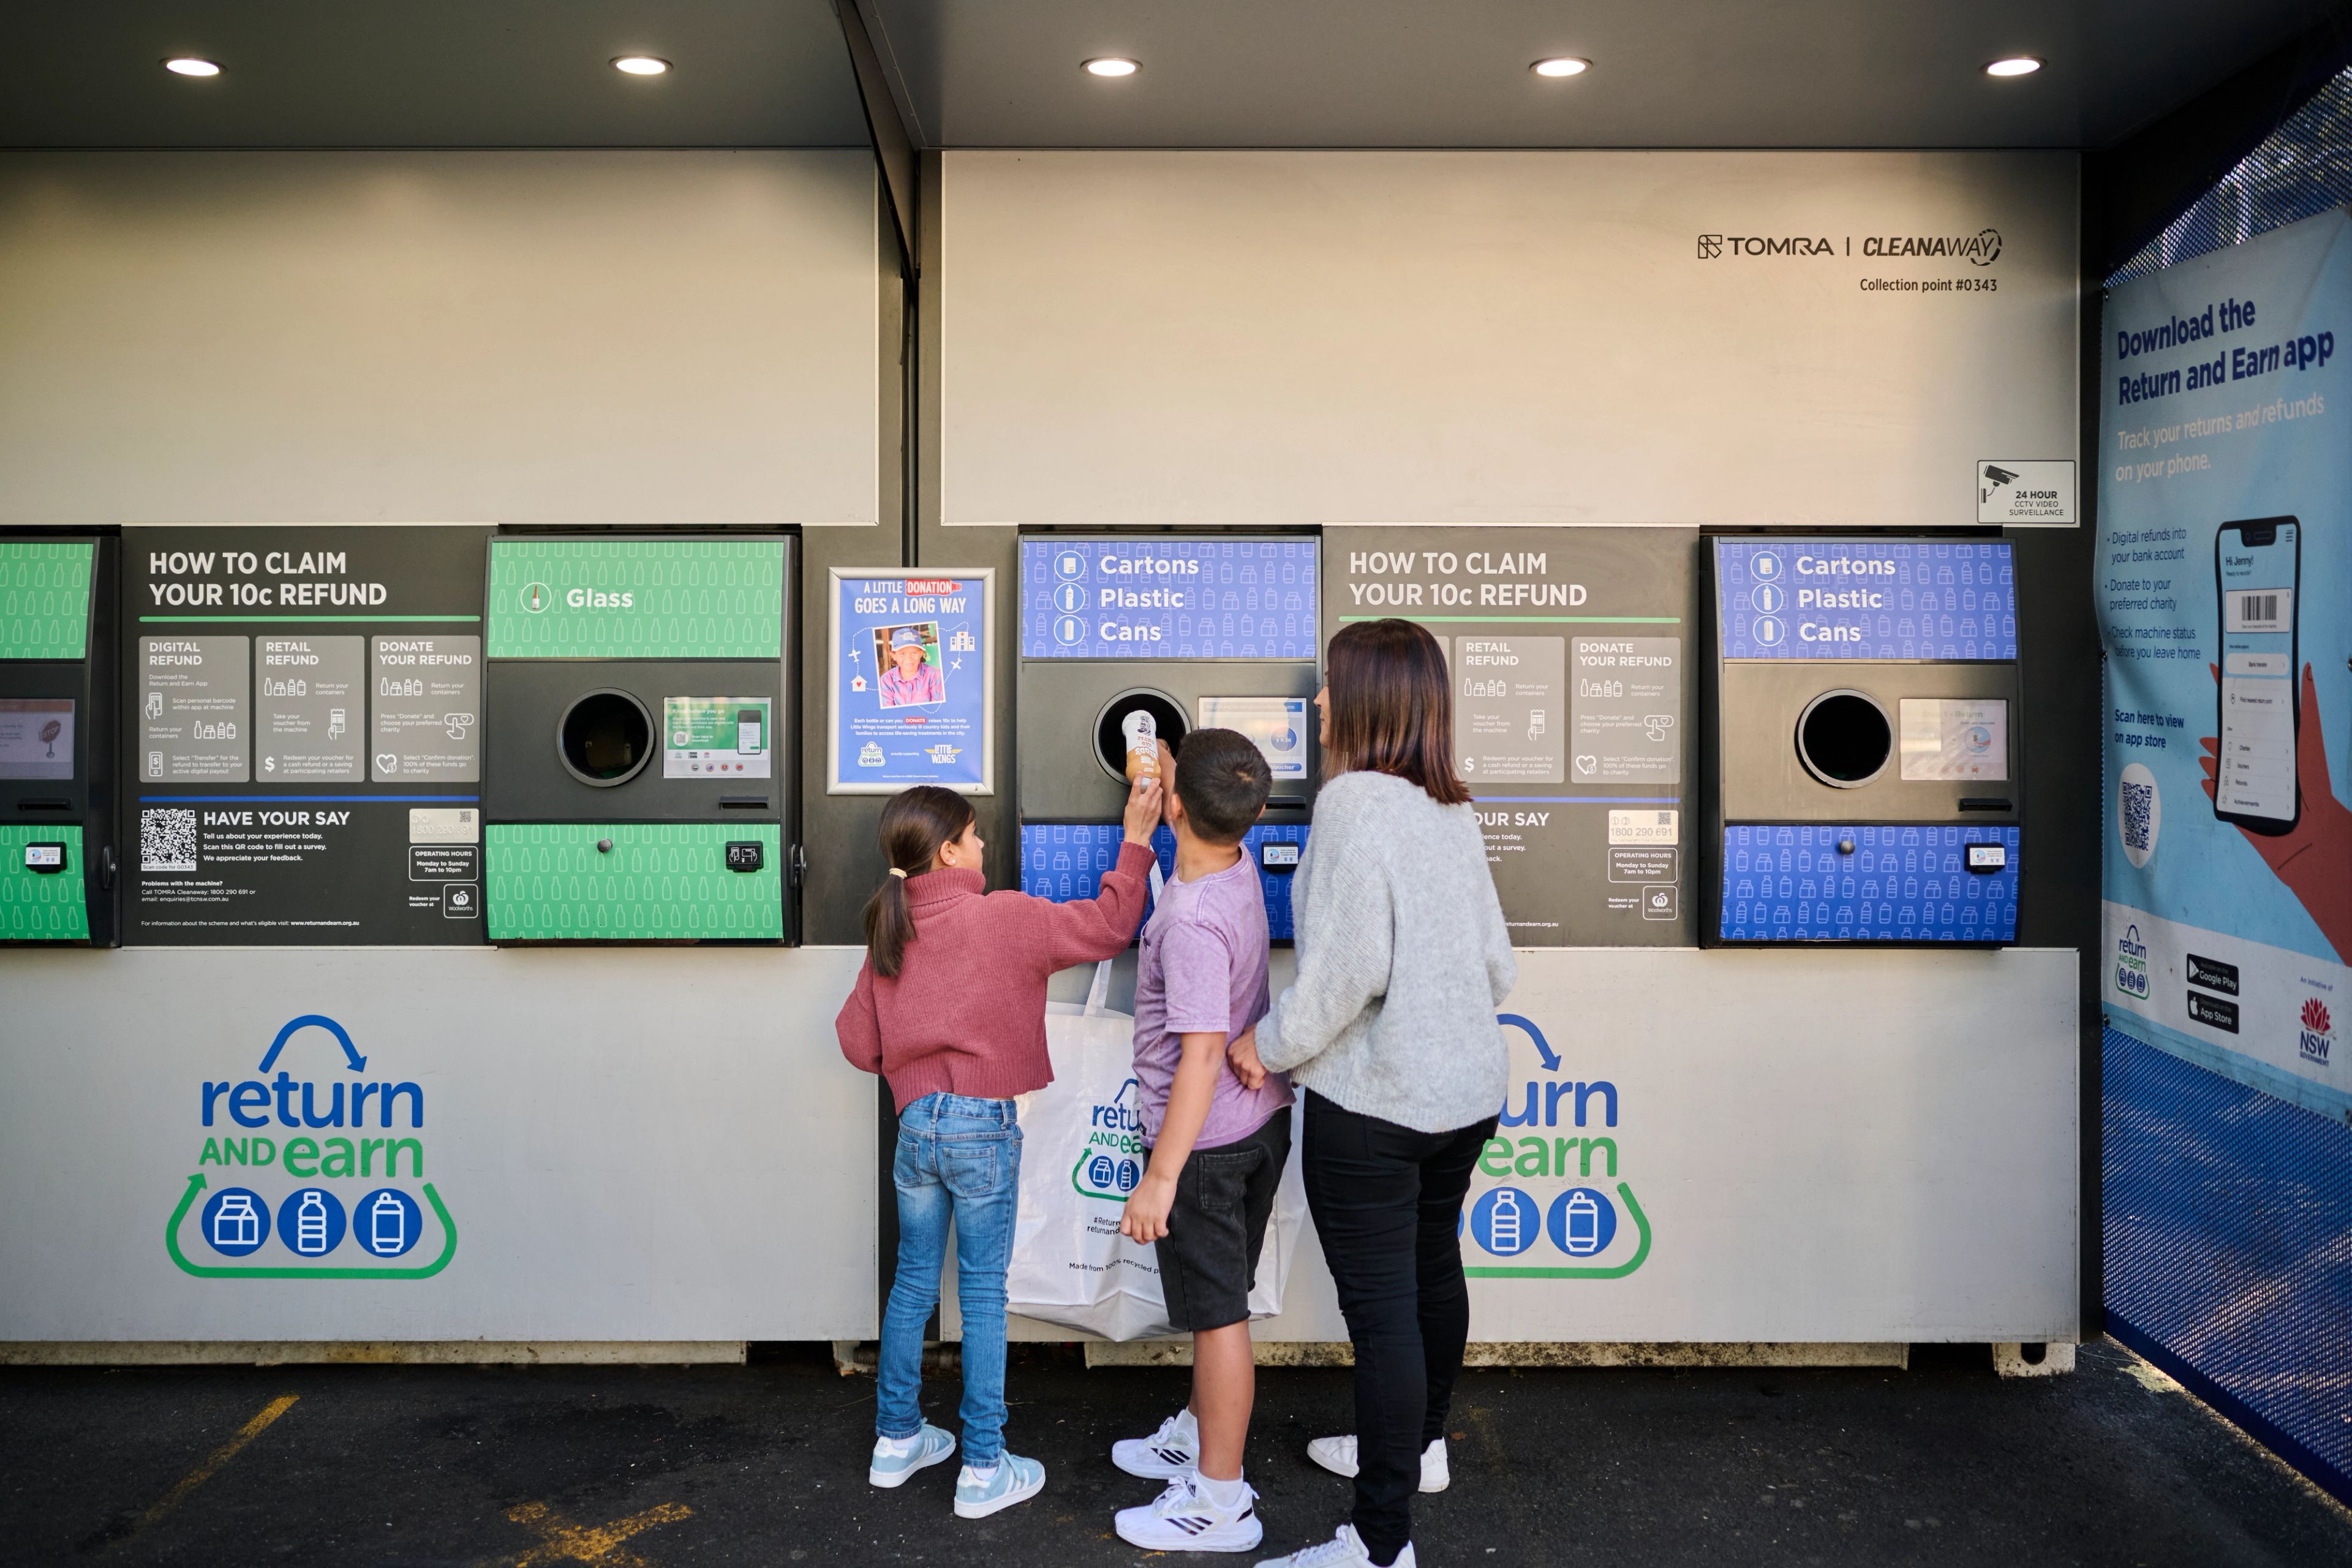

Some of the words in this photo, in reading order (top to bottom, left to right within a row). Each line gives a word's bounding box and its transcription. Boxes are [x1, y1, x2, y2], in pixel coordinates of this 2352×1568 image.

[1727, 238, 1834, 255] TOMRA
[1863, 237, 1995, 257] CLEANAWAY
[1861, 279, 1918, 290] Collection
[1923, 279, 1952, 293] point
[2118, 304, 2214, 360] Download
[2219, 298, 2255, 333] the
[2119, 368, 2180, 405] Return
[2187, 351, 2225, 390] and
[2232, 345, 2279, 380] Earn
[2284, 331, 2334, 371] app
[2118, 427, 2149, 450] Track
[2154, 423, 2180, 448] your
[2184, 416, 2232, 439] returns
[2236, 404, 2261, 429] and
[2261, 392, 2324, 423] refunds
[2116, 466, 2132, 481] on
[2136, 459, 2164, 483] your
[2168, 453, 2211, 478] phone.
[2113, 530, 2139, 545] Digital
[2141, 528, 2170, 542] refunds
[2173, 527, 2187, 539] into
[151, 552, 215, 574] HOW
[222, 552, 257, 574] TO
[265, 552, 345, 574] CLAIM
[1351, 552, 1415, 573] HOW
[1423, 552, 1457, 574] TO
[1466, 552, 1546, 574] CLAIM
[2112, 552, 2130, 565] your
[2133, 549, 2152, 562] bank
[2155, 548, 2184, 560] account
[2226, 557, 2233, 566] Hi
[1101, 556, 1199, 575] Cartons
[1796, 556, 1896, 575] Cartons
[864, 582, 870, 593] A
[873, 582, 902, 593] LITTLE
[908, 581, 952, 594] DONATION
[2111, 579, 2139, 591] Donate
[2143, 579, 2150, 590] to
[2153, 580, 2171, 592] your
[149, 584, 222, 605] YOUR
[230, 584, 272, 605] 10c
[281, 584, 386, 605] REFUND
[567, 588, 633, 608] Glass
[1101, 588, 1185, 608] Plastic
[1349, 584, 1422, 605] YOUR
[1430, 584, 1472, 605] 10c
[1481, 584, 1586, 606] REFUND
[1799, 589, 1882, 608] Plastic
[855, 598, 887, 613] GOES
[891, 598, 899, 613] A
[904, 598, 935, 613] LONG
[940, 598, 966, 613] WAY
[2109, 598, 2148, 612] preferred
[2150, 597, 2177, 611] charity
[1101, 622, 1161, 641] Cans
[1800, 622, 1861, 642] Cans
[150, 643, 200, 652] DIGITAL
[266, 642, 311, 652] RETAIL
[380, 642, 433, 651] DONATE
[1466, 643, 1510, 652] RETAIL
[1580, 643, 1633, 652] DONATE
[150, 655, 202, 665] REFUND
[266, 655, 318, 665] REFUND
[380, 655, 415, 665] YOUR
[420, 655, 471, 665] REFUND
[1466, 656, 1518, 665] REFUND
[1580, 657, 1615, 666] YOUR
[1620, 657, 1672, 666] REFUND
[2115, 709, 2135, 723] Scan
[2138, 710, 2154, 725] here
[2155, 714, 2164, 726] to
[2166, 714, 2184, 728] view
[935, 745, 952, 753] LITTLE
[2115, 733, 2124, 743] on
[2126, 734, 2143, 747] app
[2145, 734, 2166, 748] store
[932, 754, 956, 763] WINGS
[205, 812, 252, 825] HAVE
[258, 812, 309, 825] YOUR
[315, 812, 350, 825] SAY
[1474, 813, 1509, 826] OUR
[1515, 813, 1549, 826] SAY
[1656, 827, 1672, 836] 691
[2119, 938, 2146, 959] return
[2128, 957, 2146, 973] earn
[2199, 970, 2222, 985] Google
[2223, 977, 2237, 990] Play
[2201, 1008, 2214, 1020] App
[2215, 1011, 2232, 1025] Store
[2300, 1031, 2330, 1058] NSW
[2300, 1050, 2329, 1067] GOVERNMENT
[202, 1072, 423, 1128] return
[1499, 1082, 1618, 1127] urn
[1092, 1102, 1140, 1132] retu
[1089, 1132, 1119, 1147] AND
[1120, 1134, 1144, 1154] ea
[199, 1137, 276, 1166] AND
[283, 1137, 423, 1178] earn
[1477, 1137, 1618, 1177] earn
[1106, 1258, 1121, 1270] 100%
[1123, 1258, 1152, 1273] recycled
